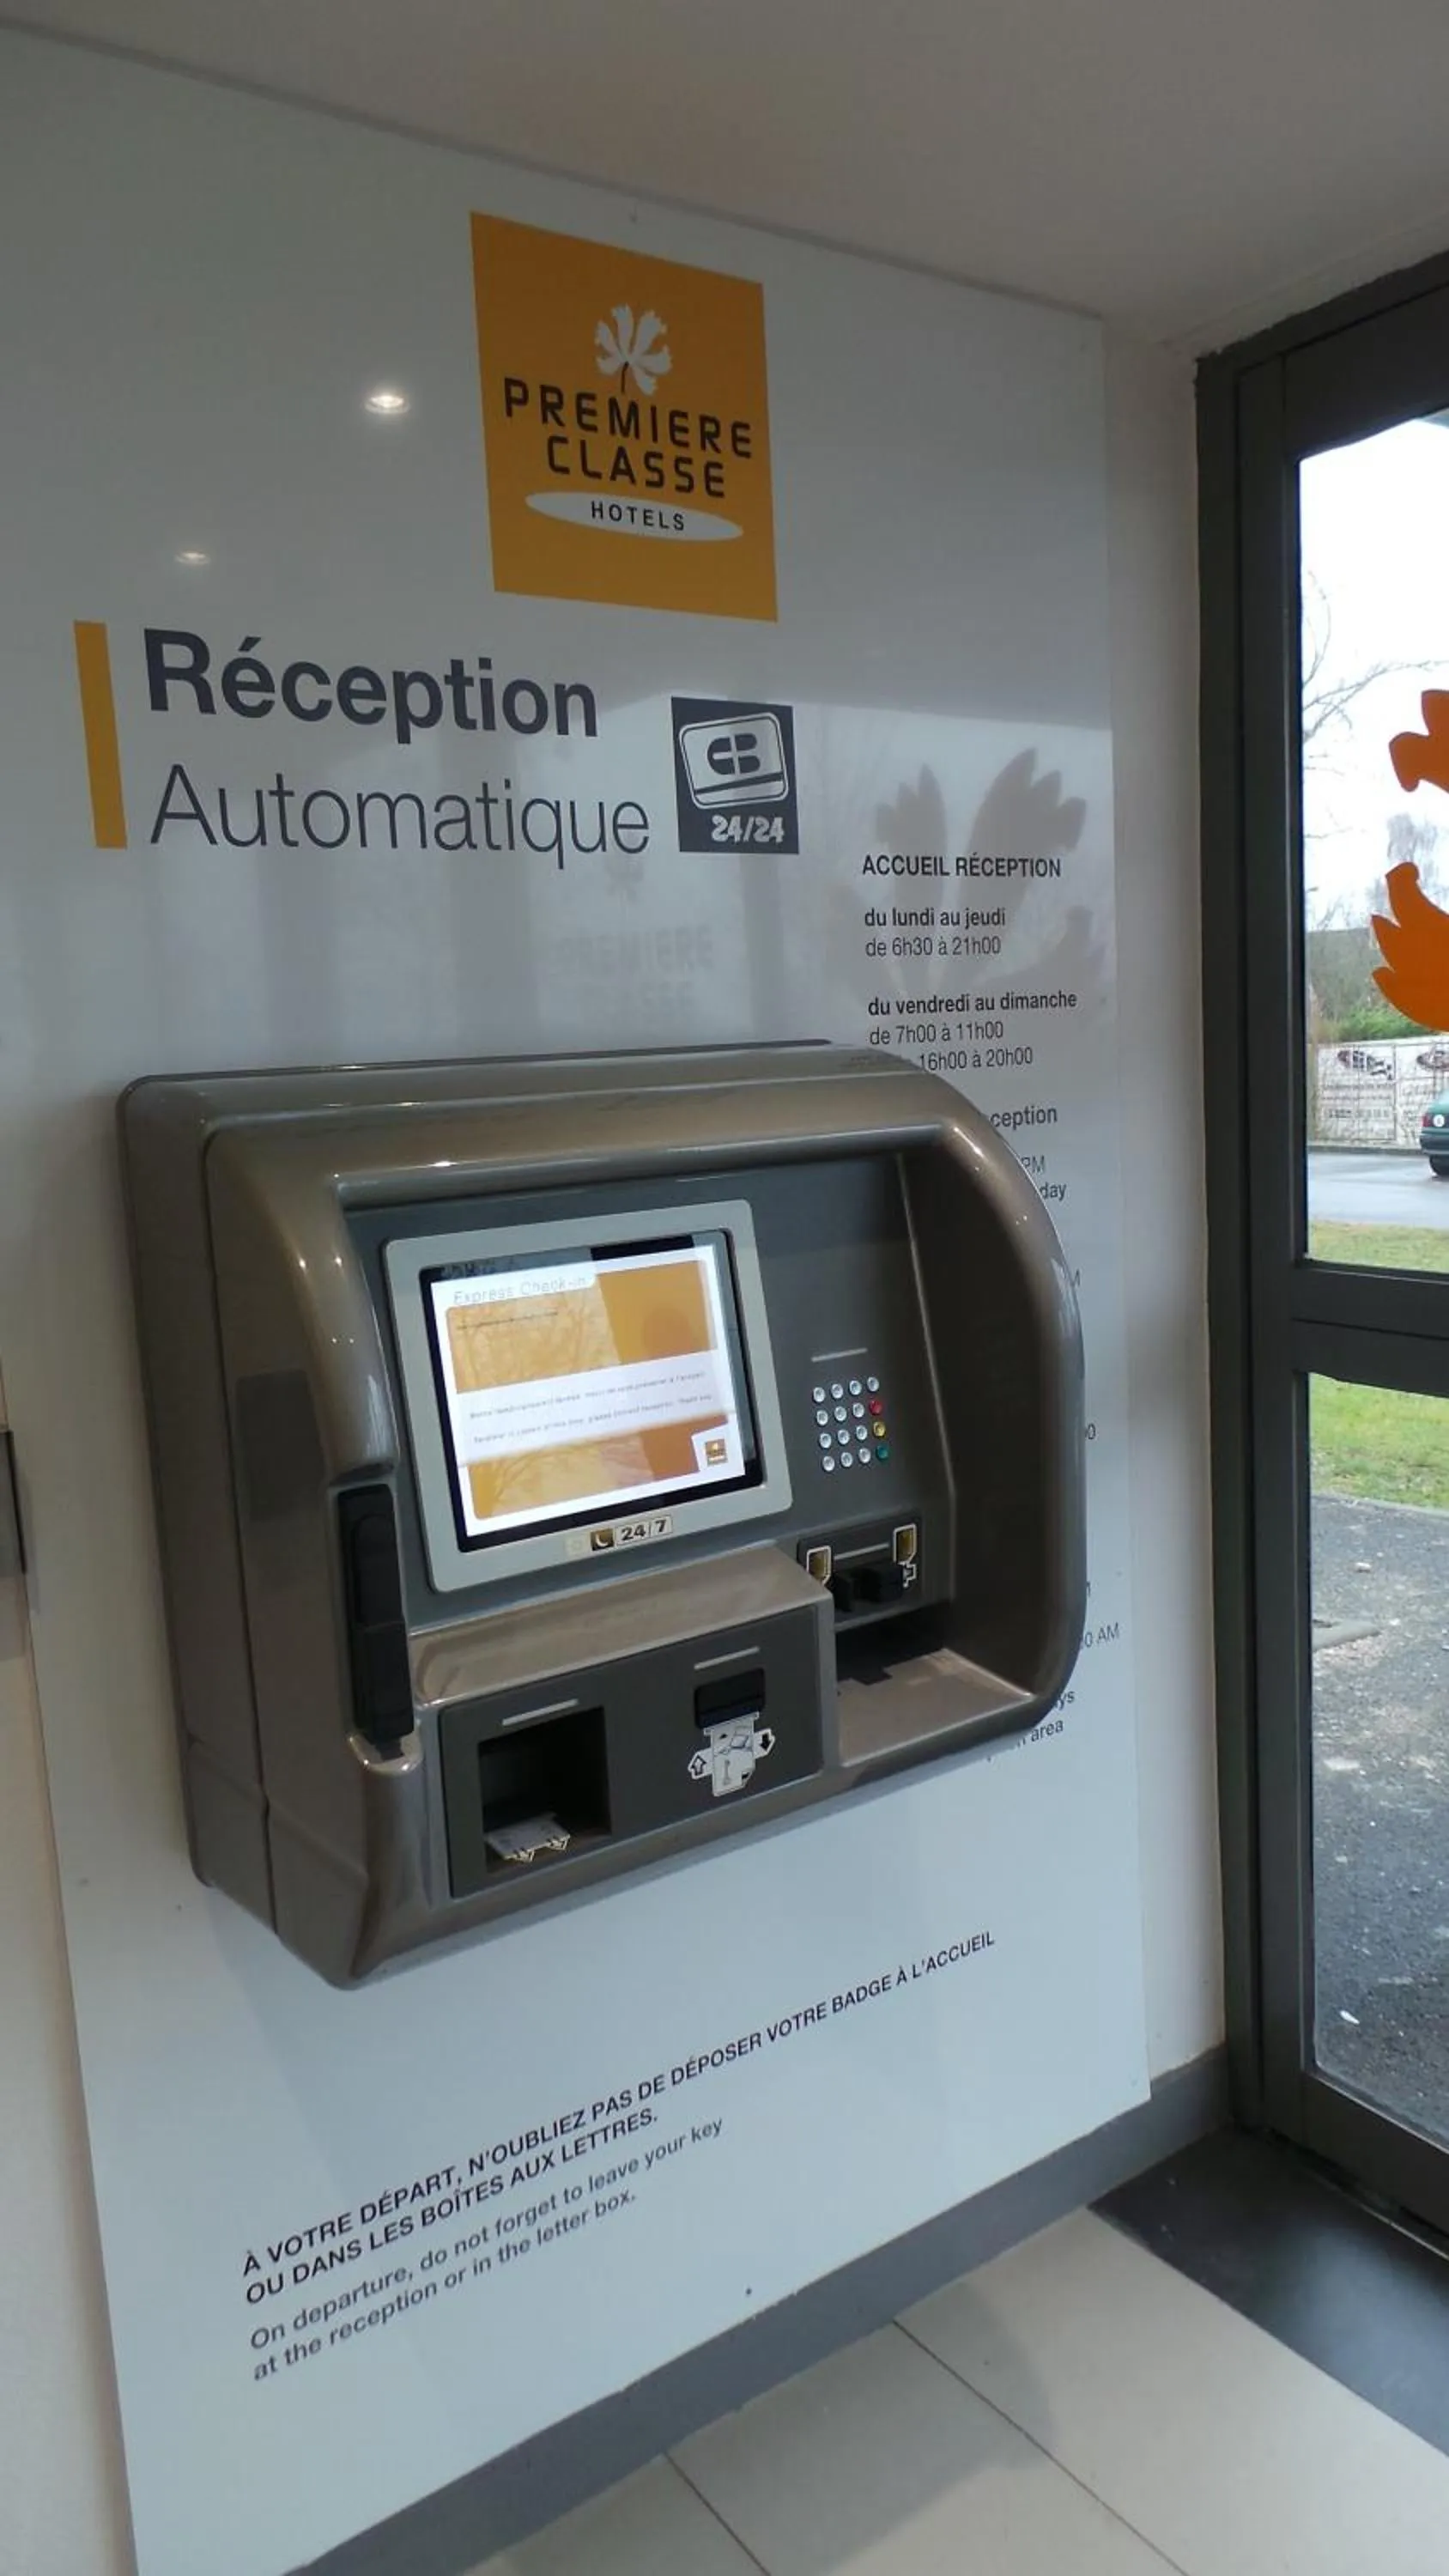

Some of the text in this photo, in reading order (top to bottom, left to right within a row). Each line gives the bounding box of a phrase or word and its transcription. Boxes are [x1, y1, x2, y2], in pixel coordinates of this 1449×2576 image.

[503, 377, 753, 459] PREMIERE
[546, 435, 726, 499] CLASSE
[591, 501, 685, 532] HOTELS
[143, 628, 598, 744] Réception
[149, 762, 650, 869] Automatique
[711, 814, 785, 843] 24/24
[862, 852, 1062, 878] ACCUEIL RÉCEPTION
[864, 908, 1006, 930] du lundi au jeudi
[865, 936, 1002, 957] de 6h30 à 21h00
[868, 991, 1077, 1016] du vendredi au dimanche
[870, 1021, 1003, 1045] de 7h00 à 11h00
[919, 1047, 1034, 1072] 16h00 à 20h00
[1097, 1622, 1120, 1644] AM
[1031, 1719, 1064, 1742] area
[243, 1930, 996, 2276] À VOTRE DÉPART, N'OUBLIEZ PAS DE DÉPOSER VOTRE BADGE À L'ACCUEIL
[246, 2106, 658, 2305] OU DANS LES BOÎTES AUX LETTRES.
[250, 2117, 724, 2350] On departure, do not forget to leave your key
[253, 2189, 637, 2381] at the reception or in the letter box.
